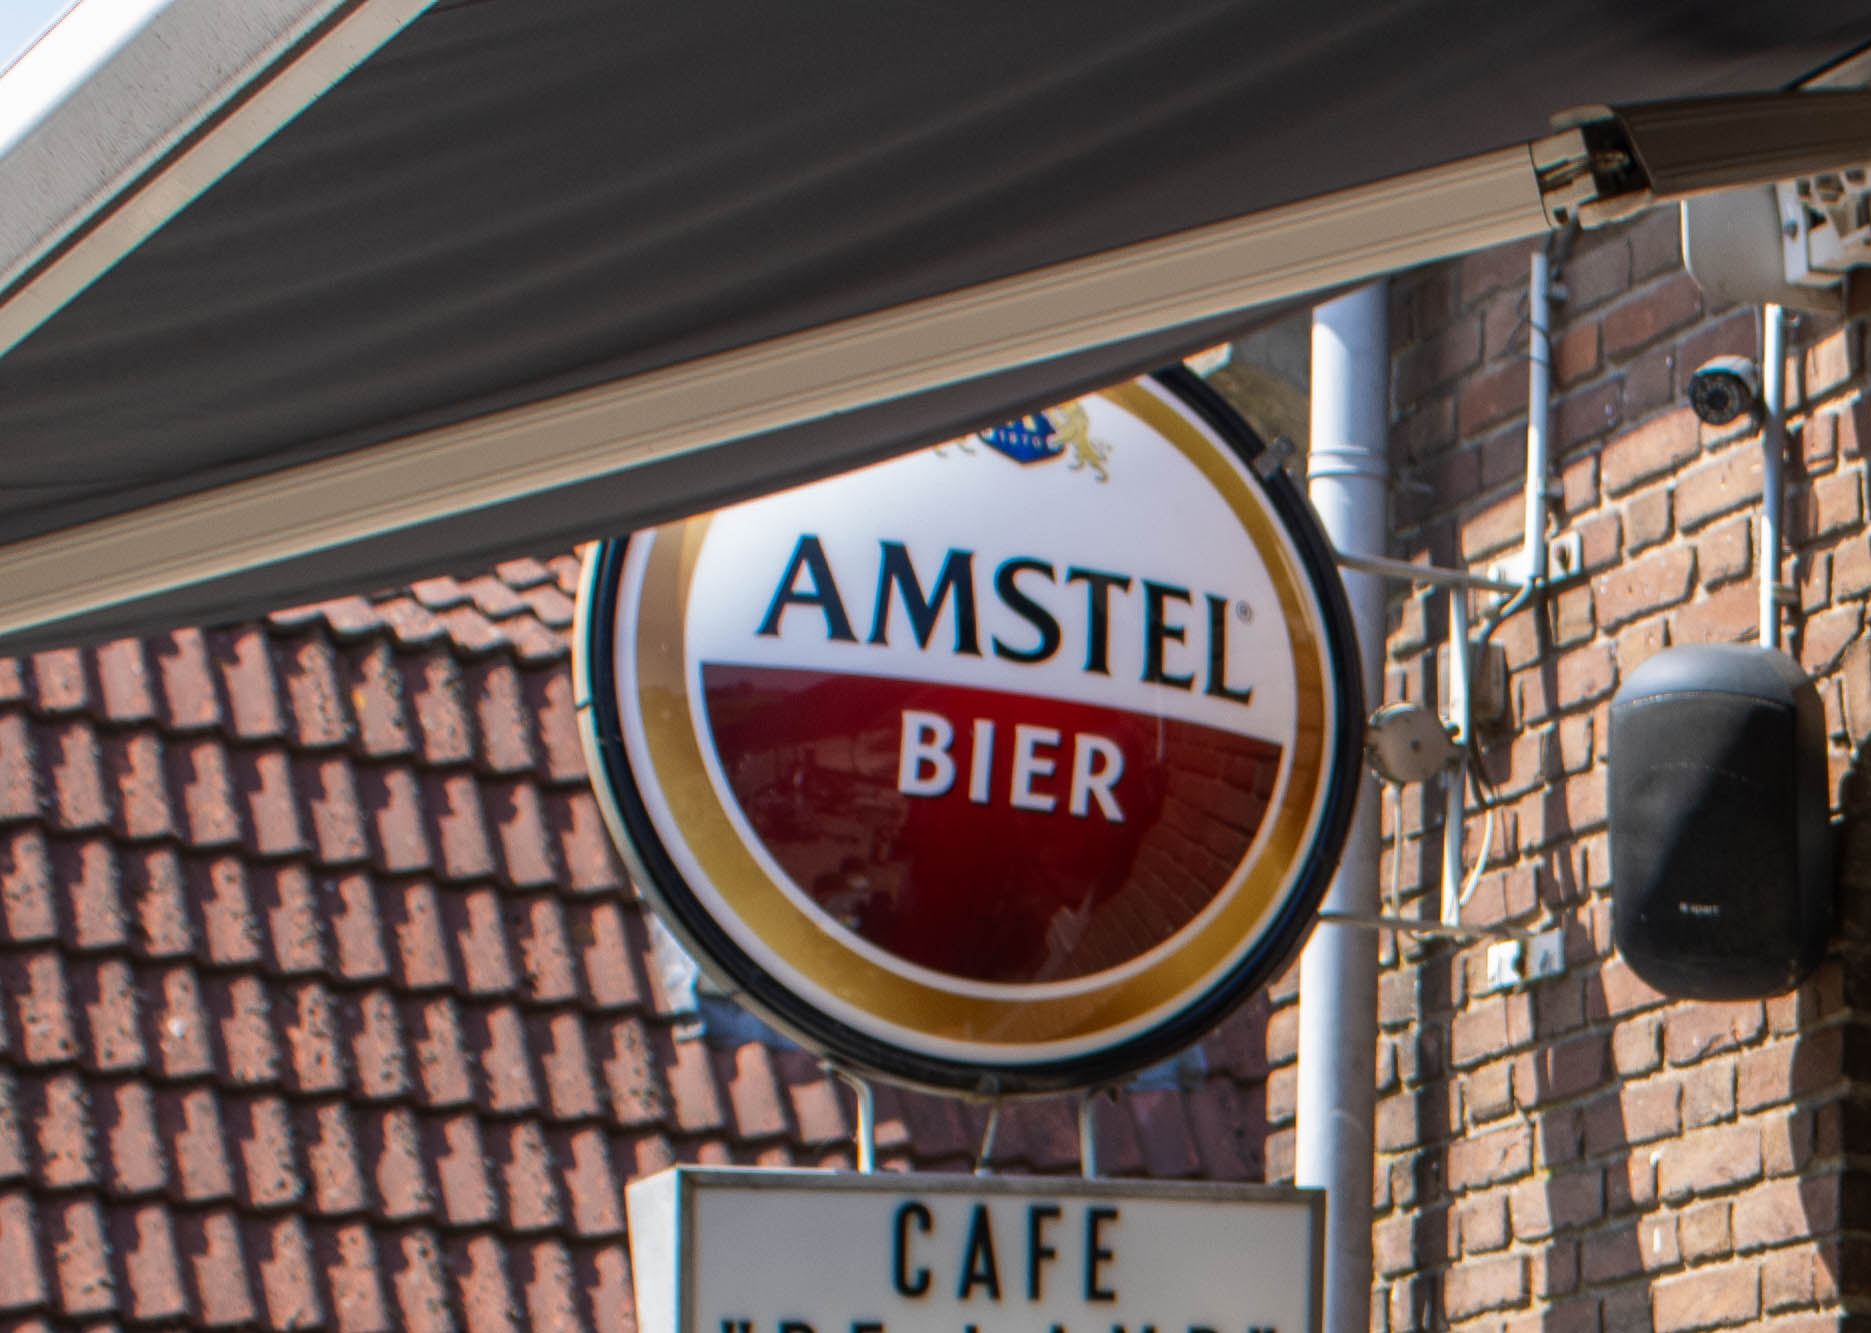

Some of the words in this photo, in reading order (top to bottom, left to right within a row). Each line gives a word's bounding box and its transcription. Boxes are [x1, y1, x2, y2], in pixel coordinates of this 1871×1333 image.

[755, 534, 1253, 704] AMSTEL
[896, 710, 1126, 823] BIER
[892, 1202, 1120, 1301] CAFE
